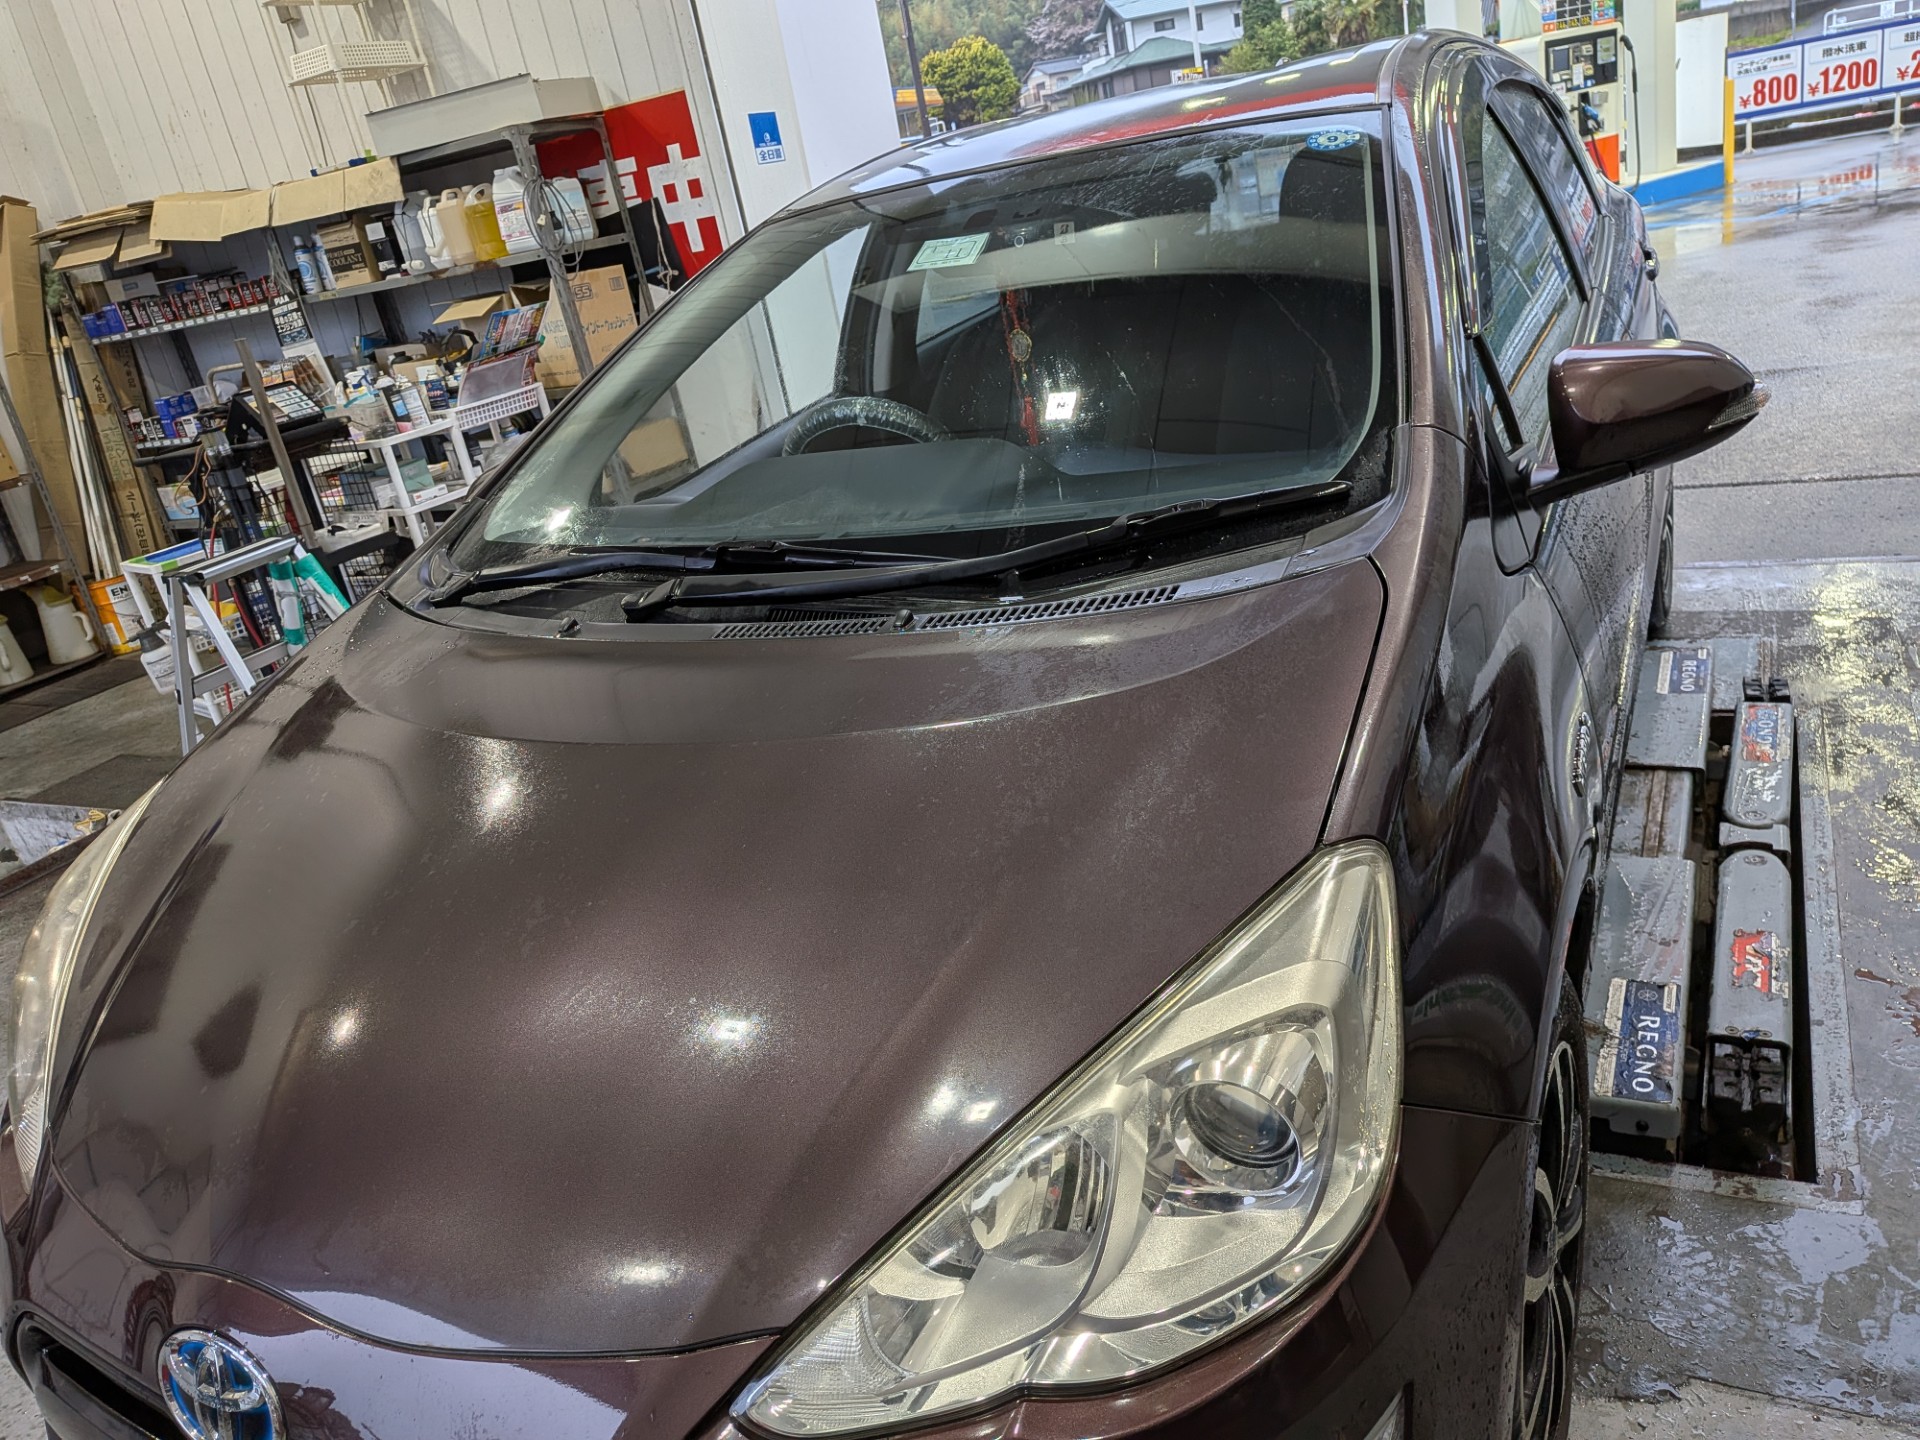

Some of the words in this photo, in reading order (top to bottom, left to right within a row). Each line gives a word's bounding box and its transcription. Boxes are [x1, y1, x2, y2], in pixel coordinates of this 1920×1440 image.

[1822, 40, 1867, 58] 撥水洗車
[1739, 73, 1798, 109] ¥800
[1807, 58, 1877, 97] ¥1200
[329, 253, 363, 268] COOLANT
[274, 294, 290, 306] PIAA
[92, 374, 108, 404] 20本入
[1680, 660, 1697, 692] REGNO
[1632, 1015, 1661, 1093] REGNO
